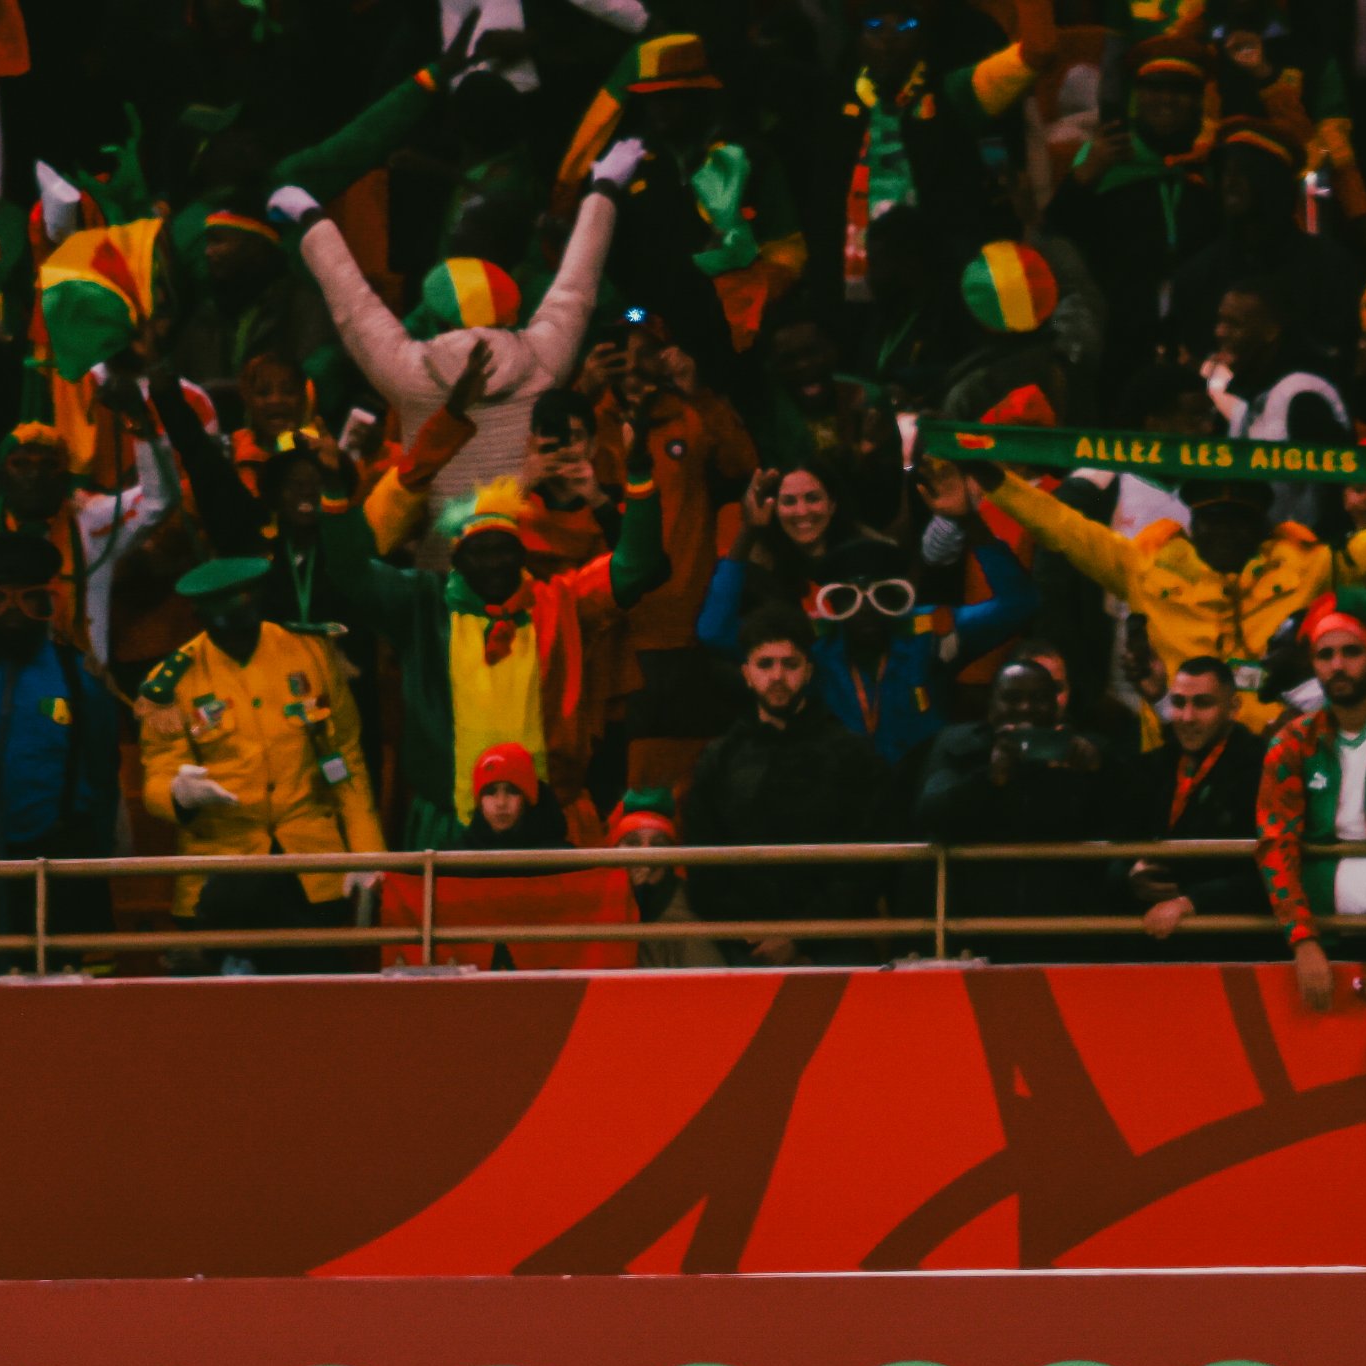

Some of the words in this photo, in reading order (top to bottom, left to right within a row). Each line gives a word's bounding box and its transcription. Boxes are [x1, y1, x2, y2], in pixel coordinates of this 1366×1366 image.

[1074, 436, 1163, 465] ALLEZ
[1180, 442, 1233, 467] LES
[1250, 446, 1358, 474] AIGLES
